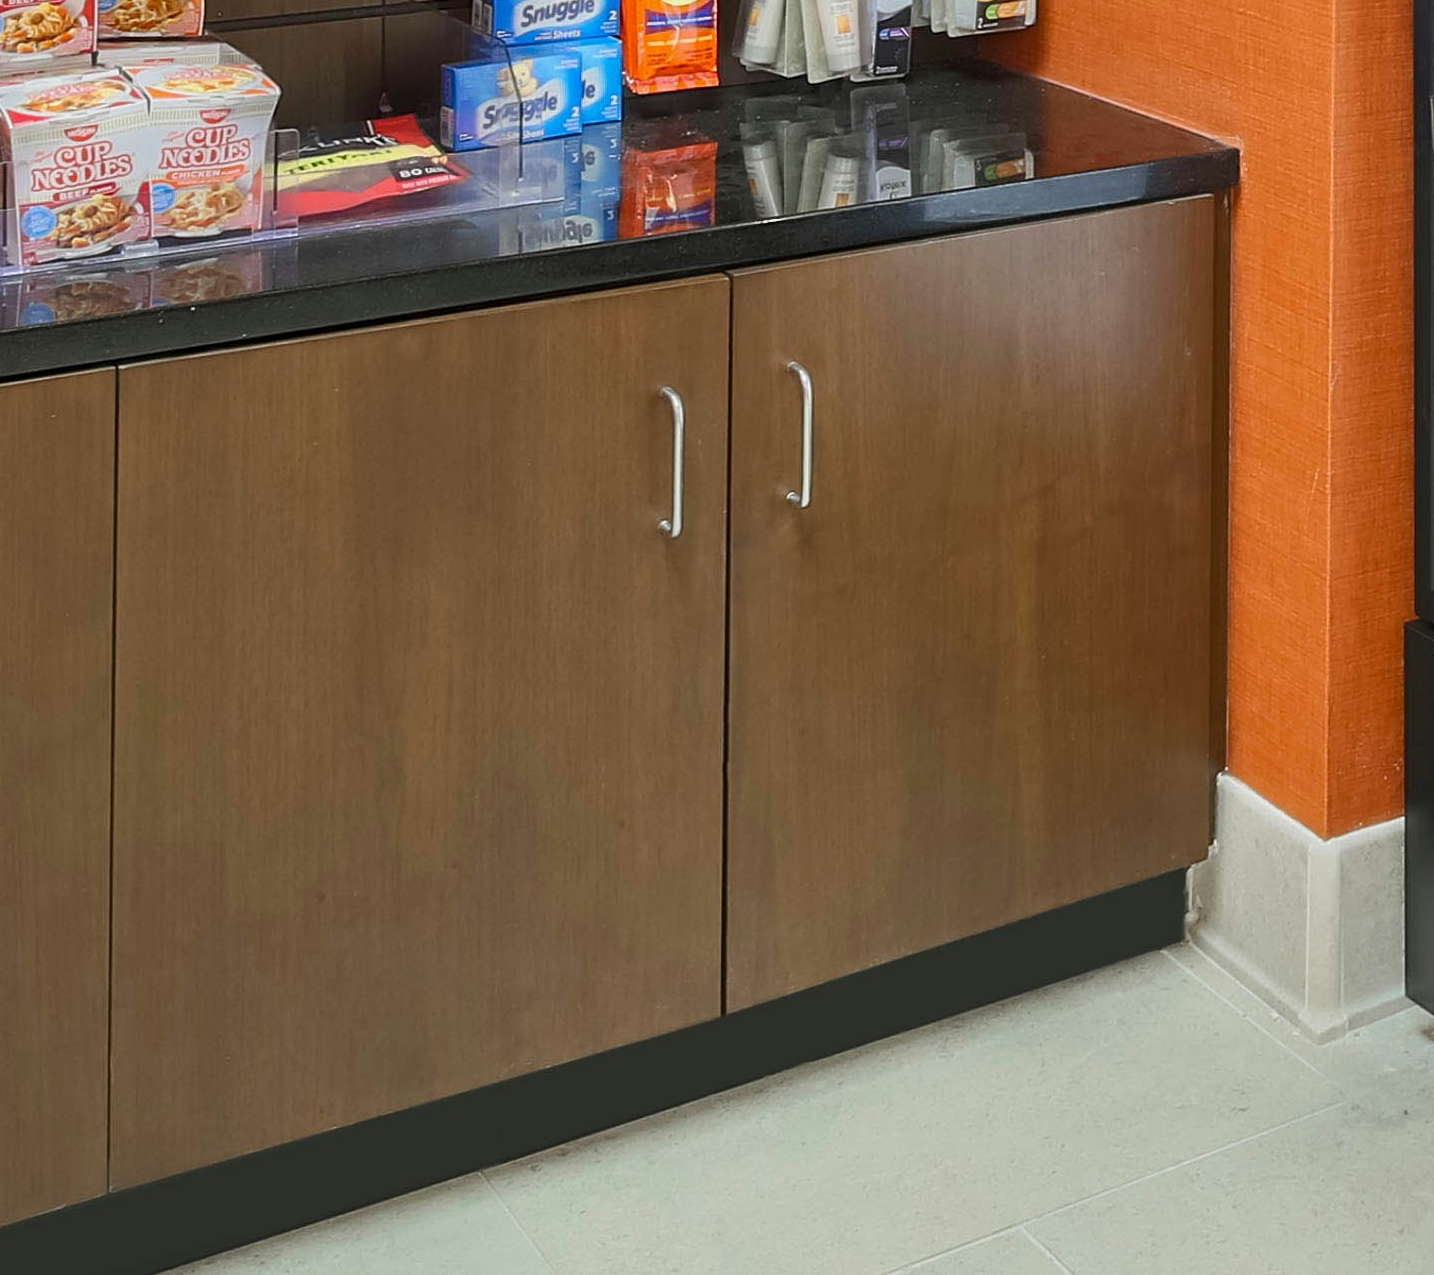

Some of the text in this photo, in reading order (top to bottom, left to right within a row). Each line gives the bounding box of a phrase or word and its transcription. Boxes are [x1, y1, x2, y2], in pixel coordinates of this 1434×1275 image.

[608, 10, 618, 21] 2
[610, 95, 619, 106] 2
[571, 107, 580, 118] 2
[185, 123, 239, 148] CUP
[53, 140, 114, 168] CUP
[158, 138, 252, 170] NOODLES
[31, 153, 134, 192] NOODLES
[170, 168, 222, 180] CHICKEN
[399, 167, 424, 179] 80
[59, 188, 91, 200] BEEF
